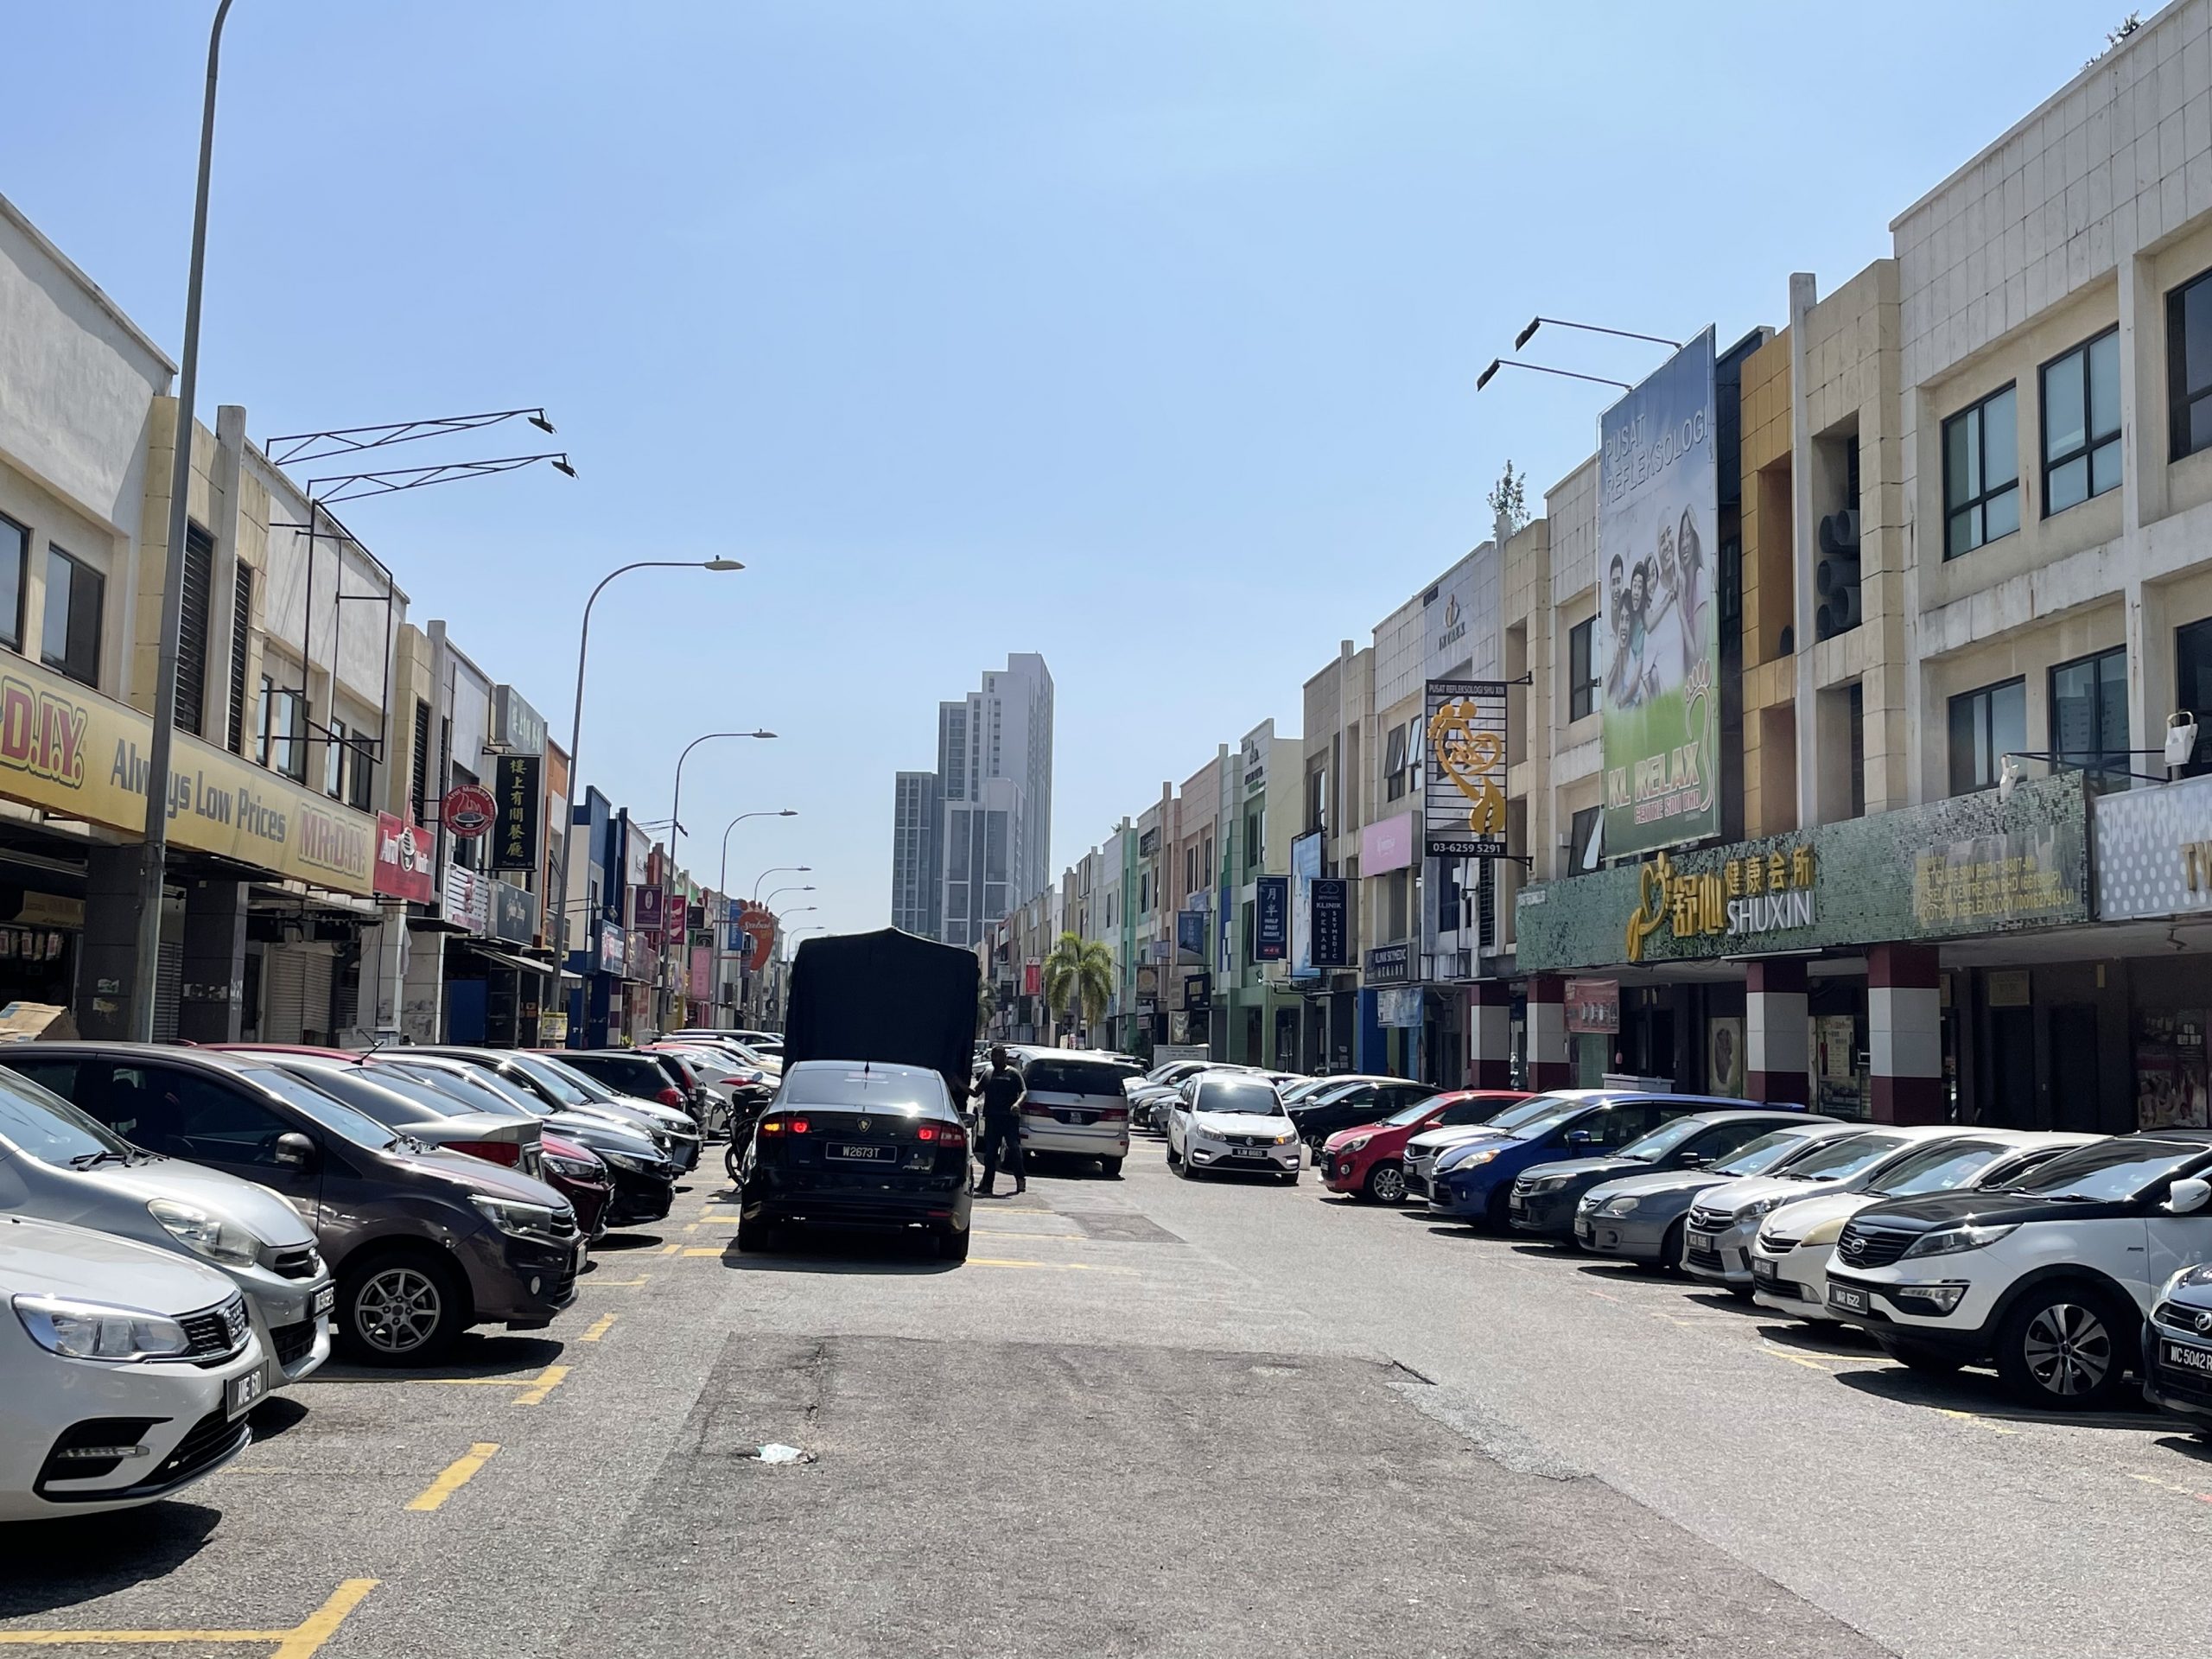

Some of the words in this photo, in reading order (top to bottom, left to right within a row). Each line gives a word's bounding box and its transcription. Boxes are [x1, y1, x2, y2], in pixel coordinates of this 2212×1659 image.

[1605, 413, 1645, 467] PUSAT
[1606, 404, 1708, 506] REFLEKSOLOGI
[1428, 683, 1446, 693] PUSAT
[110, 738, 191, 819] Alwys
[195, 770, 233, 824] Low
[237, 787, 286, 843] Prices
[1608, 766, 1631, 810] KL
[1635, 741, 1700, 803] RELAX
[1634, 799, 1663, 824] CENTRE
[1664, 793, 1682, 817] SDN
[1682, 788, 1701, 812] BHD
[1433, 842, 1475, 854] 03-6259
[1476, 843, 1501, 854] 5291
[1725, 843, 1814, 897] 健康会所
[1672, 870, 1727, 938] 舒心
[1953, 882, 1982, 899] CENTRE
[1985, 880, 2000, 894] SDN
[2001, 876, 2018, 893] BHD
[1957, 895, 2014, 917] REFLEXOLOGY
[1726, 890, 1813, 936] SHUXIN
[842, 1145, 880, 1159] W2673T
